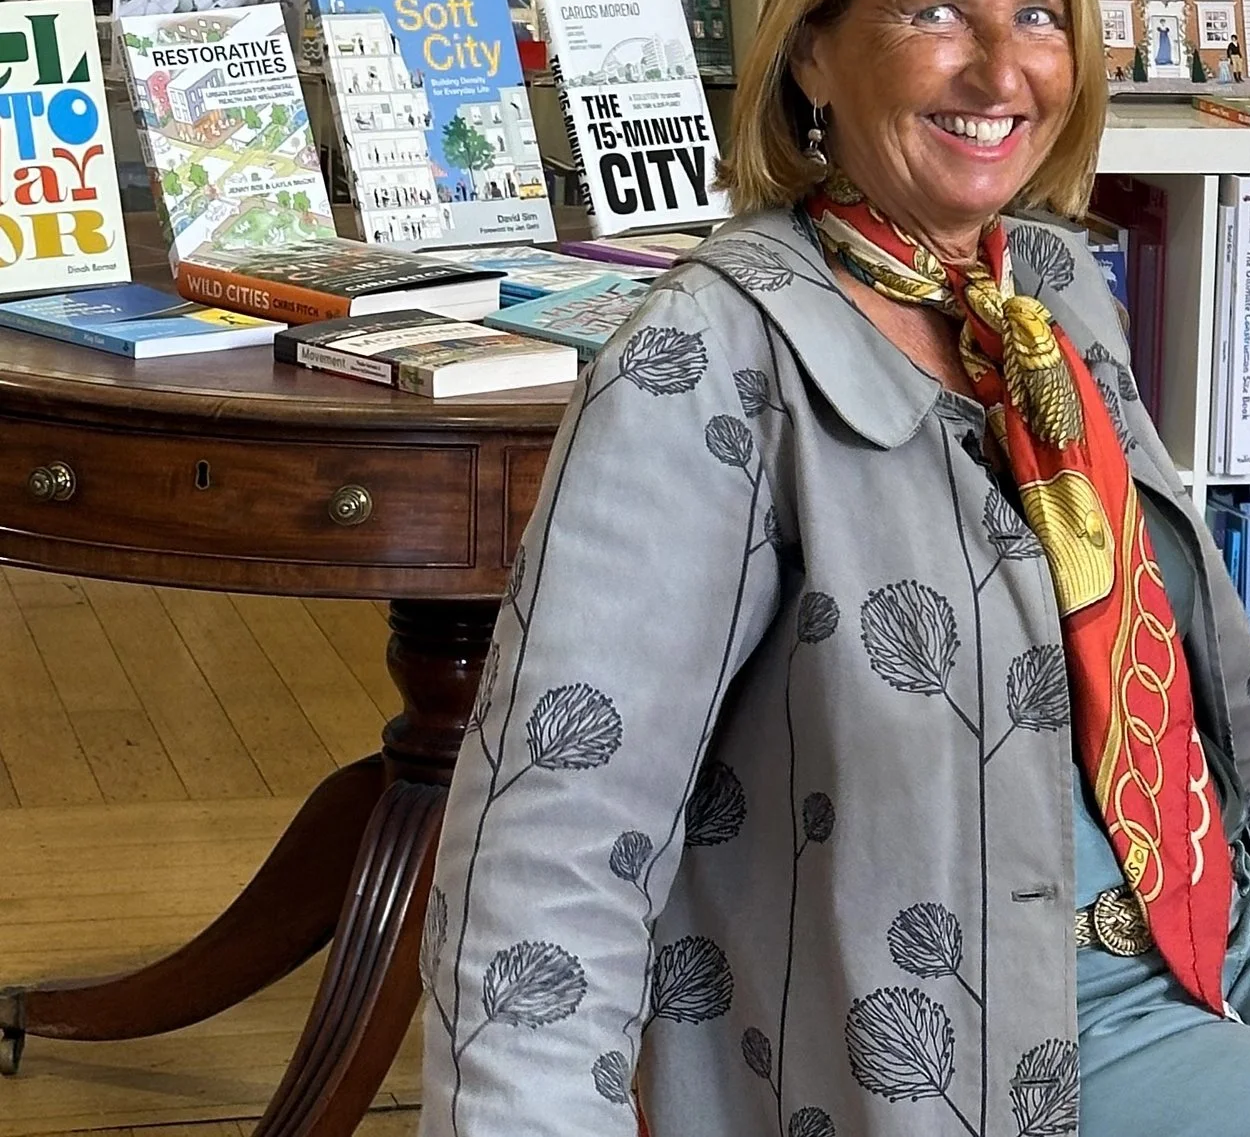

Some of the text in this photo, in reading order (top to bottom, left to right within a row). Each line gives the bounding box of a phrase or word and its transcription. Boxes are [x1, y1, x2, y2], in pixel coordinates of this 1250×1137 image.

[561, 2, 641, 21] CARLOS MORENO
[152, 39, 284, 67] RESTORATIVE
[422, 32, 501, 77] City
[226, 57, 287, 79] CITIES
[205, 89, 228, 99] URBAN
[228, 88, 253, 97] DESIGN
[253, 86, 266, 94] FOR
[431, 76, 486, 88] Building Density
[433, 85, 491, 97] for Everyday Life
[218, 90, 296, 105] HEALTH AND WELLBEING
[580, 93, 623, 120] THE
[0, 88, 99, 162] TO
[548, 54, 596, 216] THE 15-MINUTE CITY
[587, 114, 710, 151] 15-MINUTE
[599, 146, 710, 215] CITY
[497, 212, 538, 224] David Sim
[187, 275, 320, 318] WILD CITIES CHRIS FITCH
[301, 347, 347, 369] Movement
[1242, 375, 1250, 393] Site
[1241, 396, 1250, 420] Book
